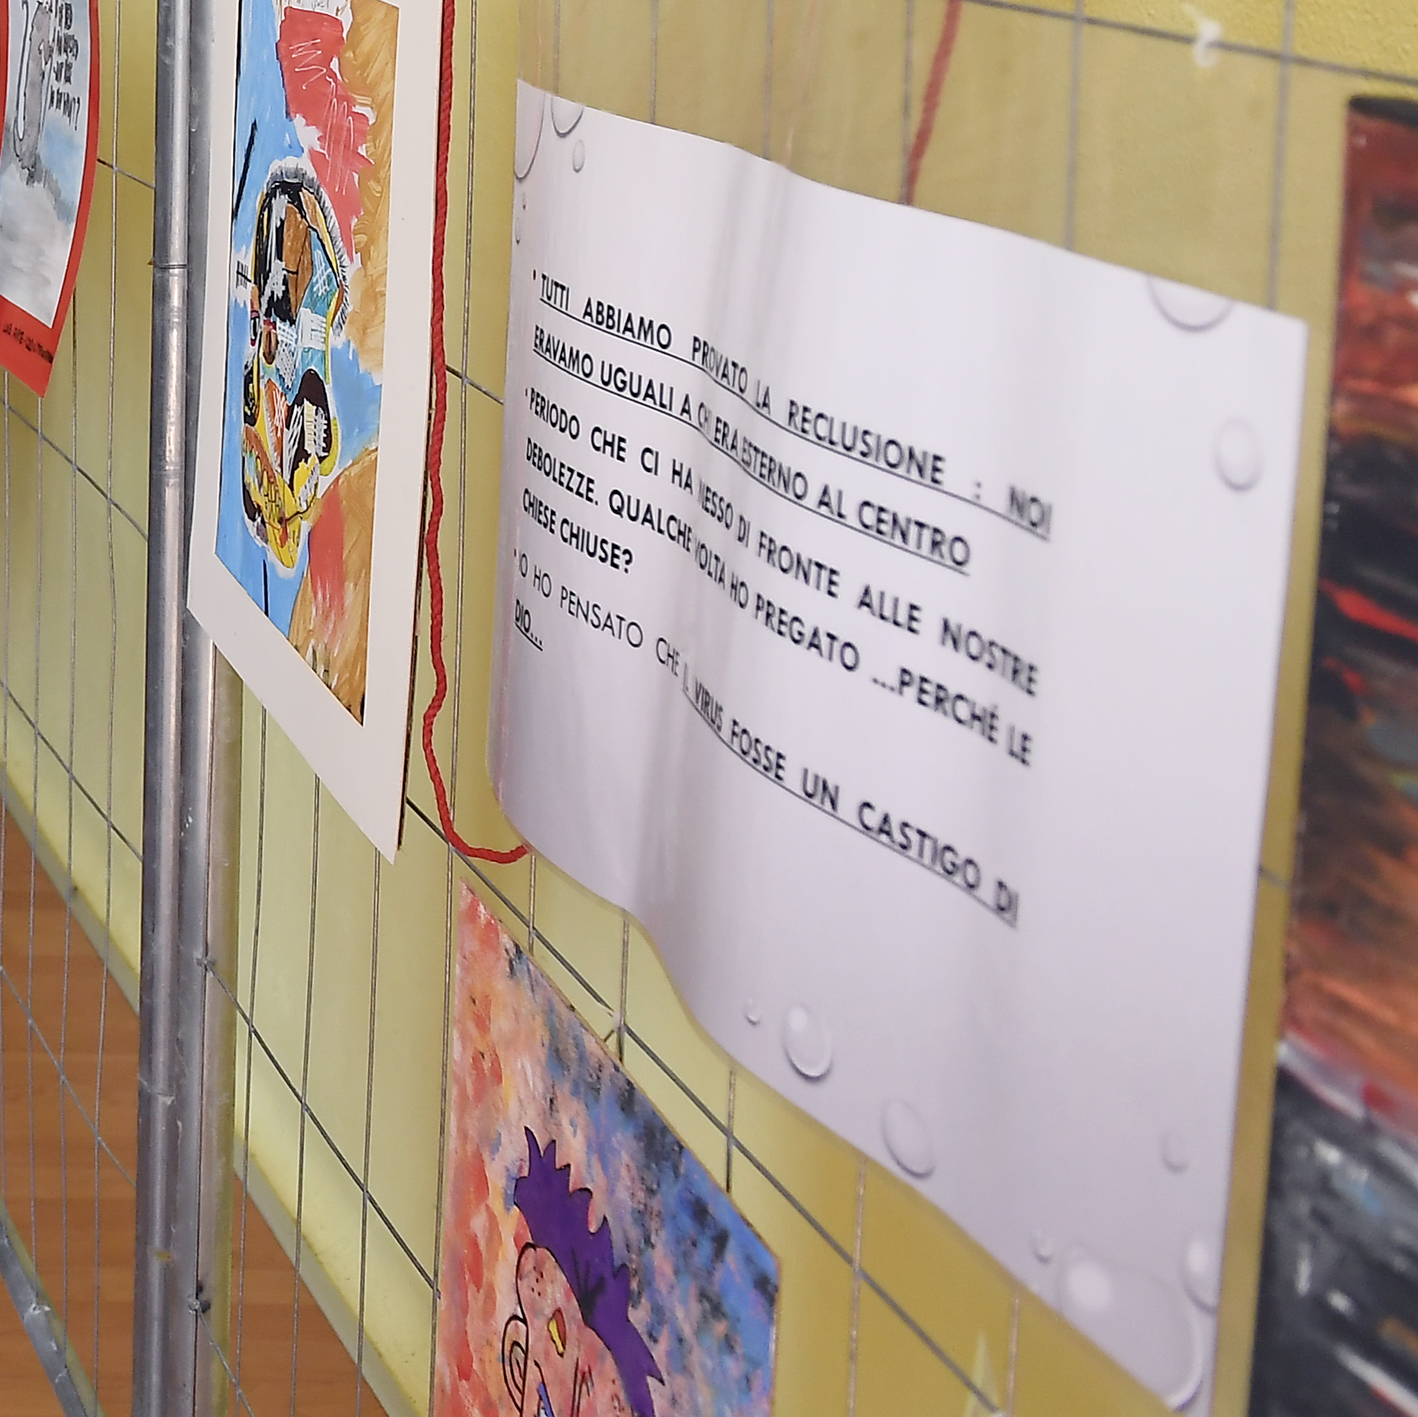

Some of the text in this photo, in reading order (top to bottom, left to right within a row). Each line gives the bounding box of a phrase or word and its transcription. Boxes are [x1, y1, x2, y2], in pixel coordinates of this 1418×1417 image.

[522, 488, 634, 574] CHIESE CHIUSE?
[529, 387, 581, 440] PERIODO
[590, 425, 628, 463] CHE
[640, 445, 660, 477] CI
[671, 458, 694, 495] HA
[736, 514, 751, 549] DI
[756, 529, 840, 599] FRONTE
[856, 584, 922, 635] ALLE
[939, 617, 1038, 697] NOSTRE
[533, 324, 594, 379] ERAVAMO
[600, 359, 674, 412] UGUALI
[679, 393, 692, 422] A
[713, 415, 740, 456] ERA
[740, 435, 809, 501] ESTERNO
[817, 483, 847, 520] AL
[858, 500, 971, 567] CENTRO
[540, 273, 1053, 536] TUTTI ABBIAMO PROVATO LA RECLUSIONE NOI
[525, 437, 599, 506] DEBOLEZZE.
[608, 488, 694, 554] QUALCHE
[693, 533, 726, 590] VOLTA
[729, 571, 750, 610] HO
[753, 592, 860, 673] PREGATO
[1008, 723, 1033, 768] LE
[533, 565, 1019, 925] HO PENSATO CHE VIRUS FOSSE UN CASTIGO DI
